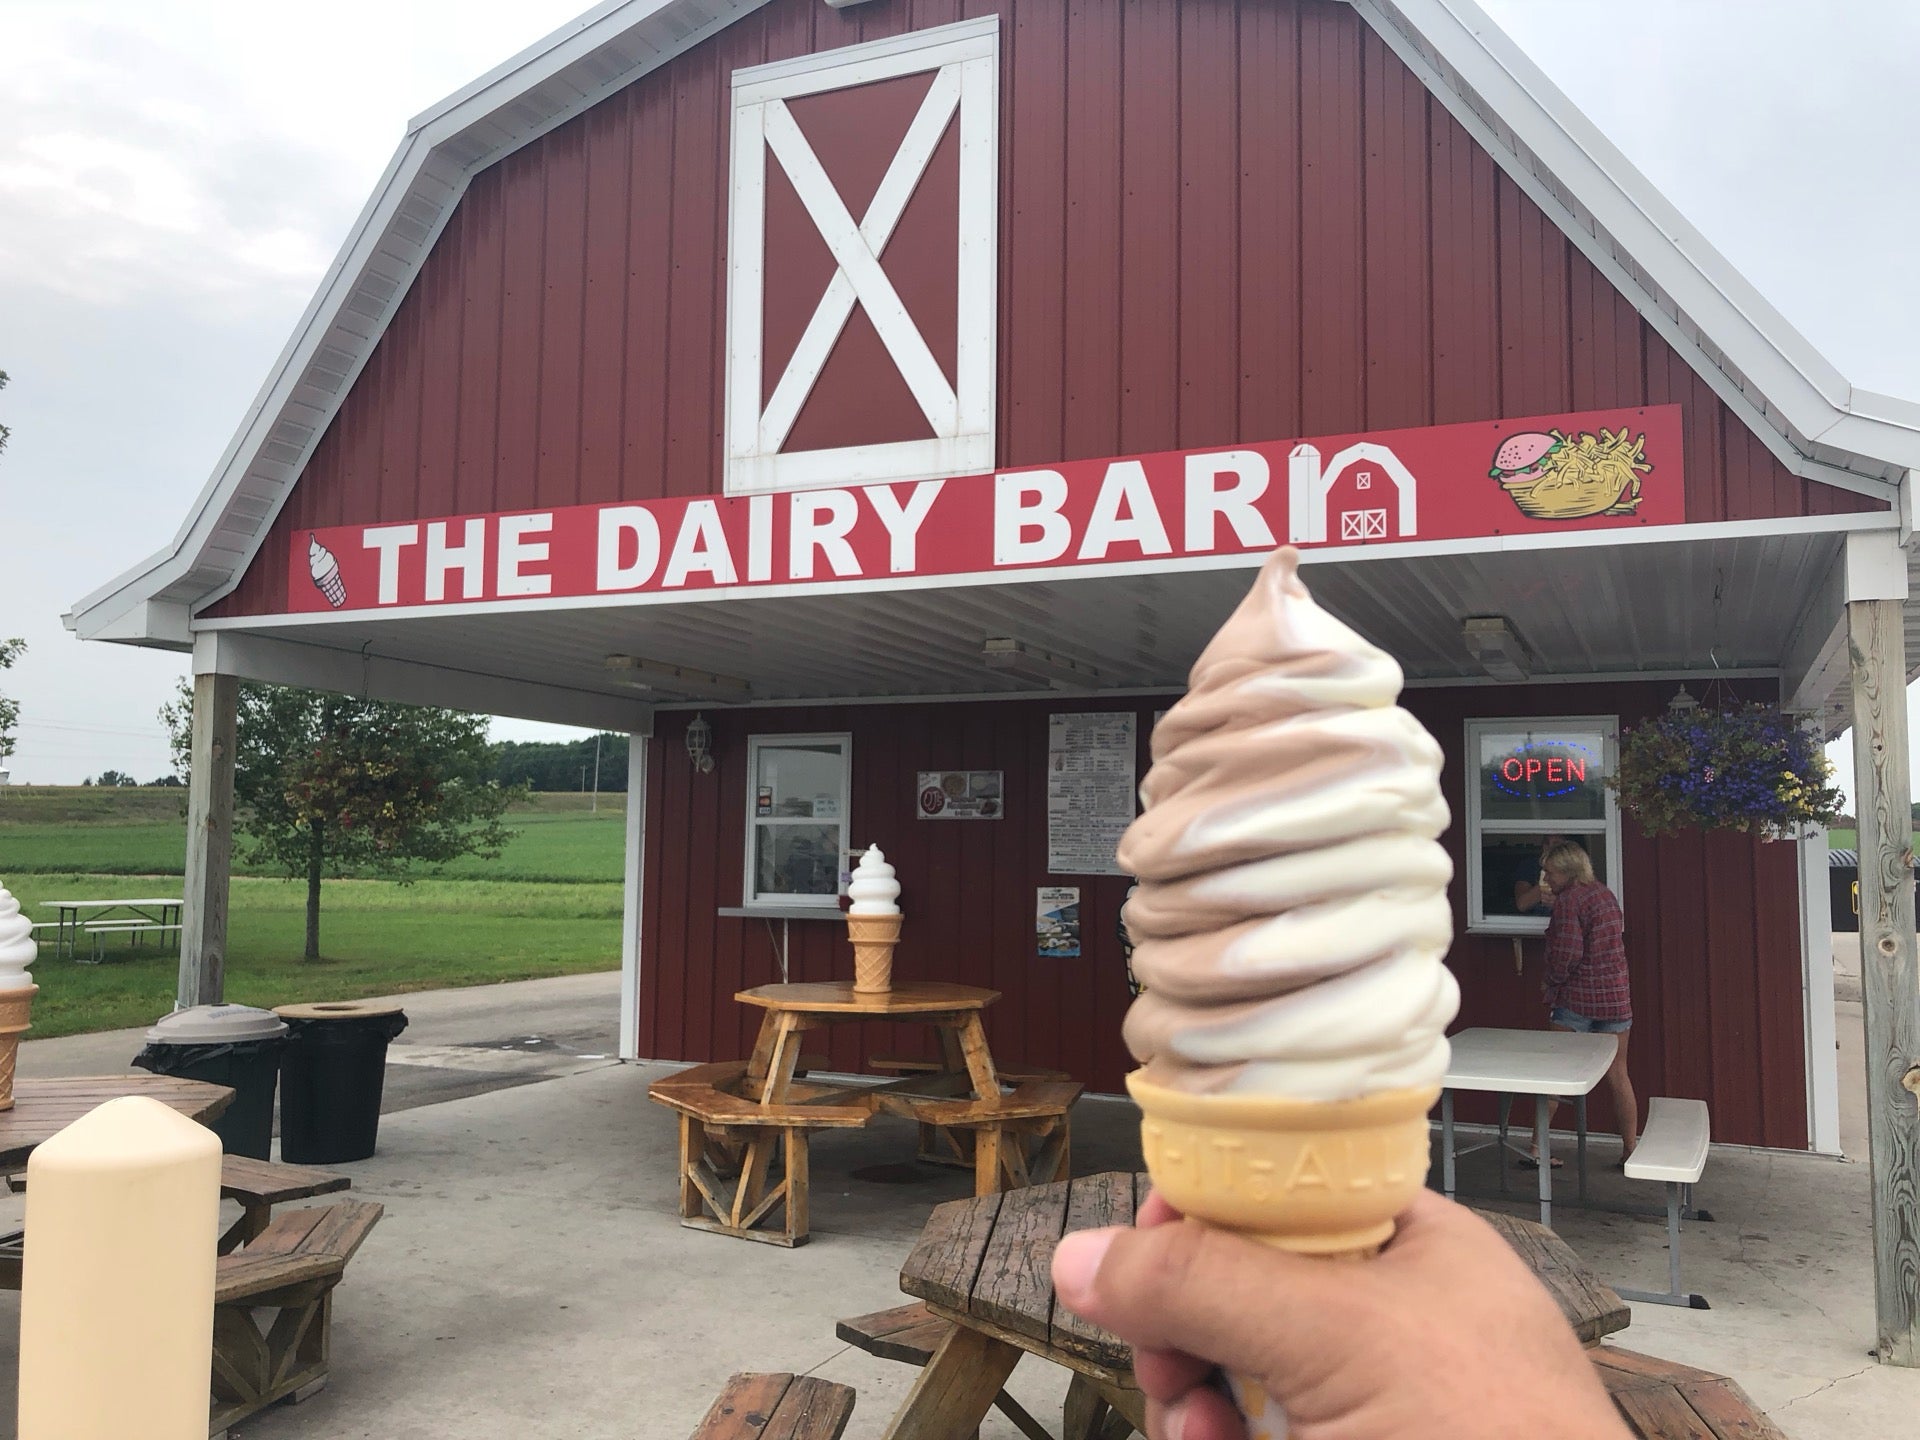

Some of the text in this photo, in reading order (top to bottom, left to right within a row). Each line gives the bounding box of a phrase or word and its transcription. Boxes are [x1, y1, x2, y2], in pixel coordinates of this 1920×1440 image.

[362, 512, 553, 604] THE
[596, 480, 947, 591] DAIRY
[1502, 757, 1586, 782] OPEN
